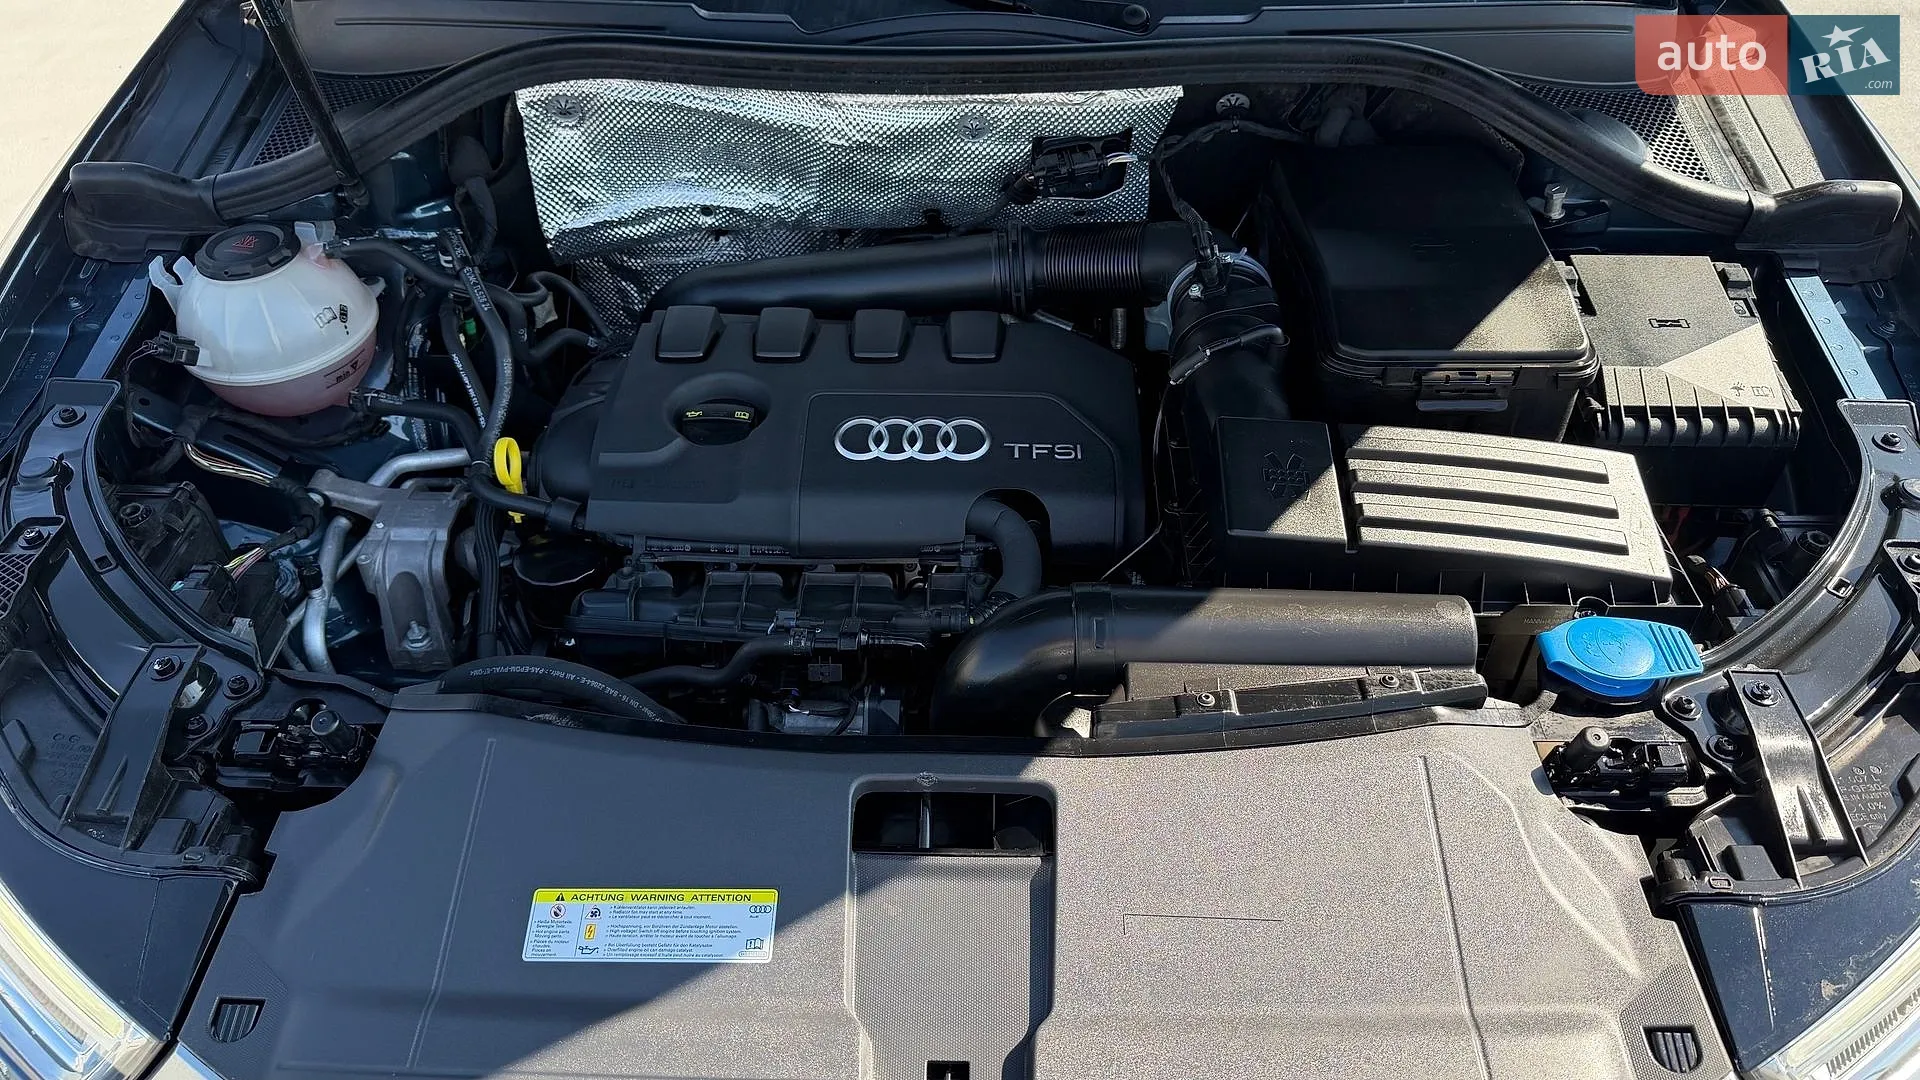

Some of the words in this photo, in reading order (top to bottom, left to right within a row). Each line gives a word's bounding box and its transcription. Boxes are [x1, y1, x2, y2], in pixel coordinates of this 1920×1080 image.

[1004, 443, 1082, 460] TFSI
[571, 894, 625, 902] ACHTUNG
[631, 894, 685, 902] WARNING
[690, 894, 752, 902] ATTENTION
